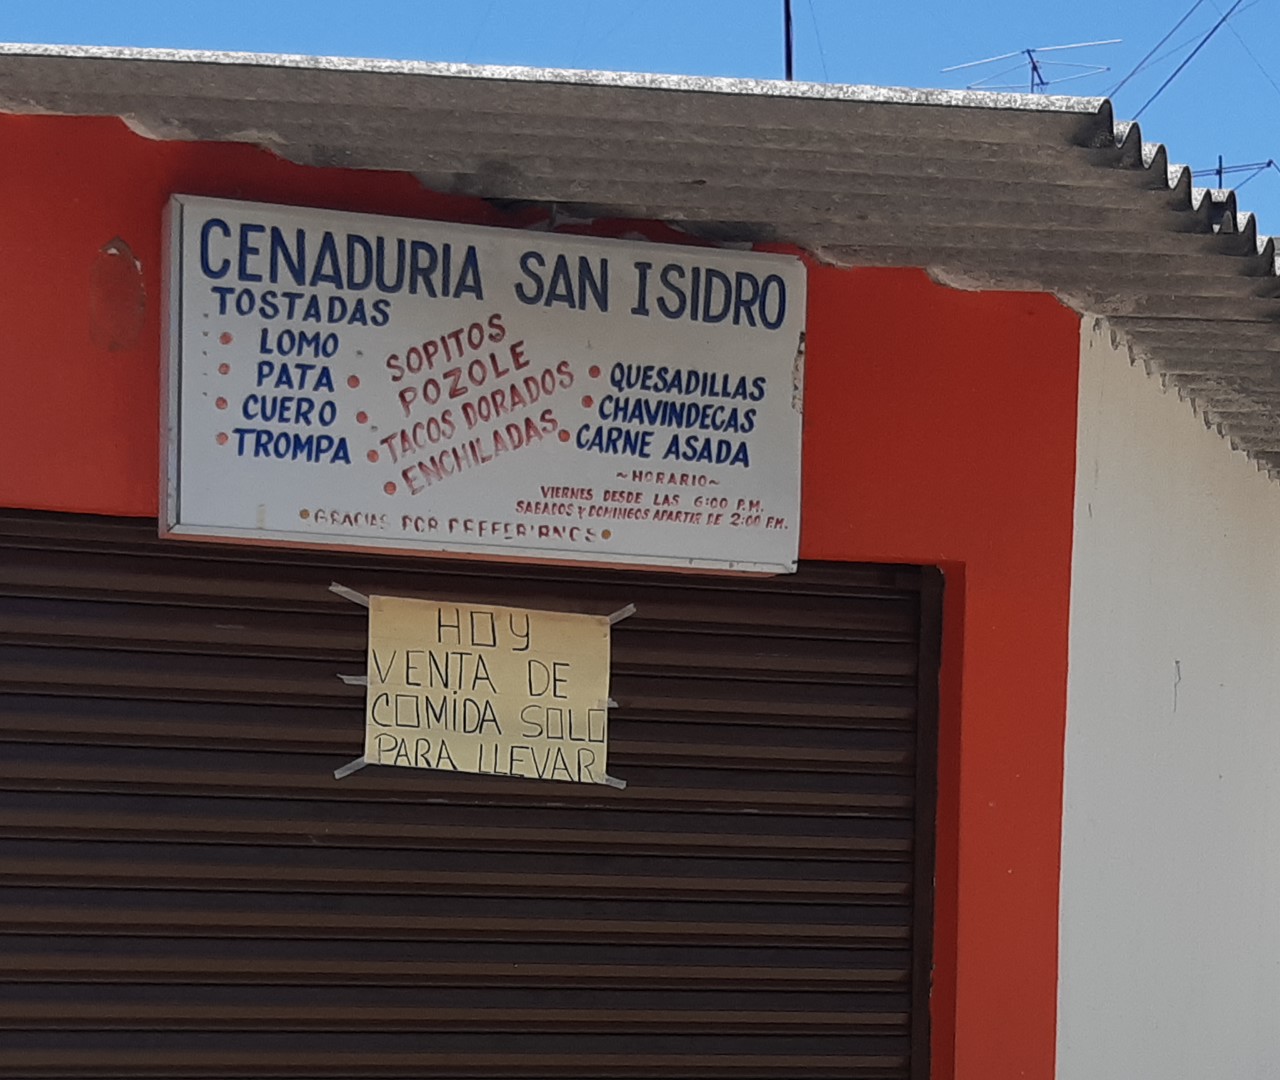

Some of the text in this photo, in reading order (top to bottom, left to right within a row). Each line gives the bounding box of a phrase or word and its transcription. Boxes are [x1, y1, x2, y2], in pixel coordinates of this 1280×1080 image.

[200, 217, 787, 331] CENADURIA SAN ISIDRO
[210, 286, 392, 327] TOSTADAS
[259, 327, 340, 359] LOMO
[385, 312, 507, 383] SOPITOS
[256, 360, 335, 393] PATA
[398, 339, 531, 418] POZOLE
[609, 361, 767, 402] QUESADILLAS
[241, 393, 338, 427] CUERO
[380, 360, 575, 465] TACOS DORADOS
[598, 393, 757, 434] CHAVINDECAS
[231, 427, 352, 465] TROMPA
[401, 408, 560, 496] ENCHILADAS
[575, 423, 751, 468] CARNE ASADA
[515, 500, 575, 517] SABADOS
[587, 504, 651, 521] DOMINGOS
[728, 512, 762, 527] 2:00
[540, 485, 765, 513] VIERNES DESDE LAS 6:00 P.M.
[437, 607, 530, 652] HOY
[372, 648, 571, 700] VENTA DE
[371, 690, 606, 744] COMIDA SOLO
[374, 732, 598, 784] PARA LLEVAR
